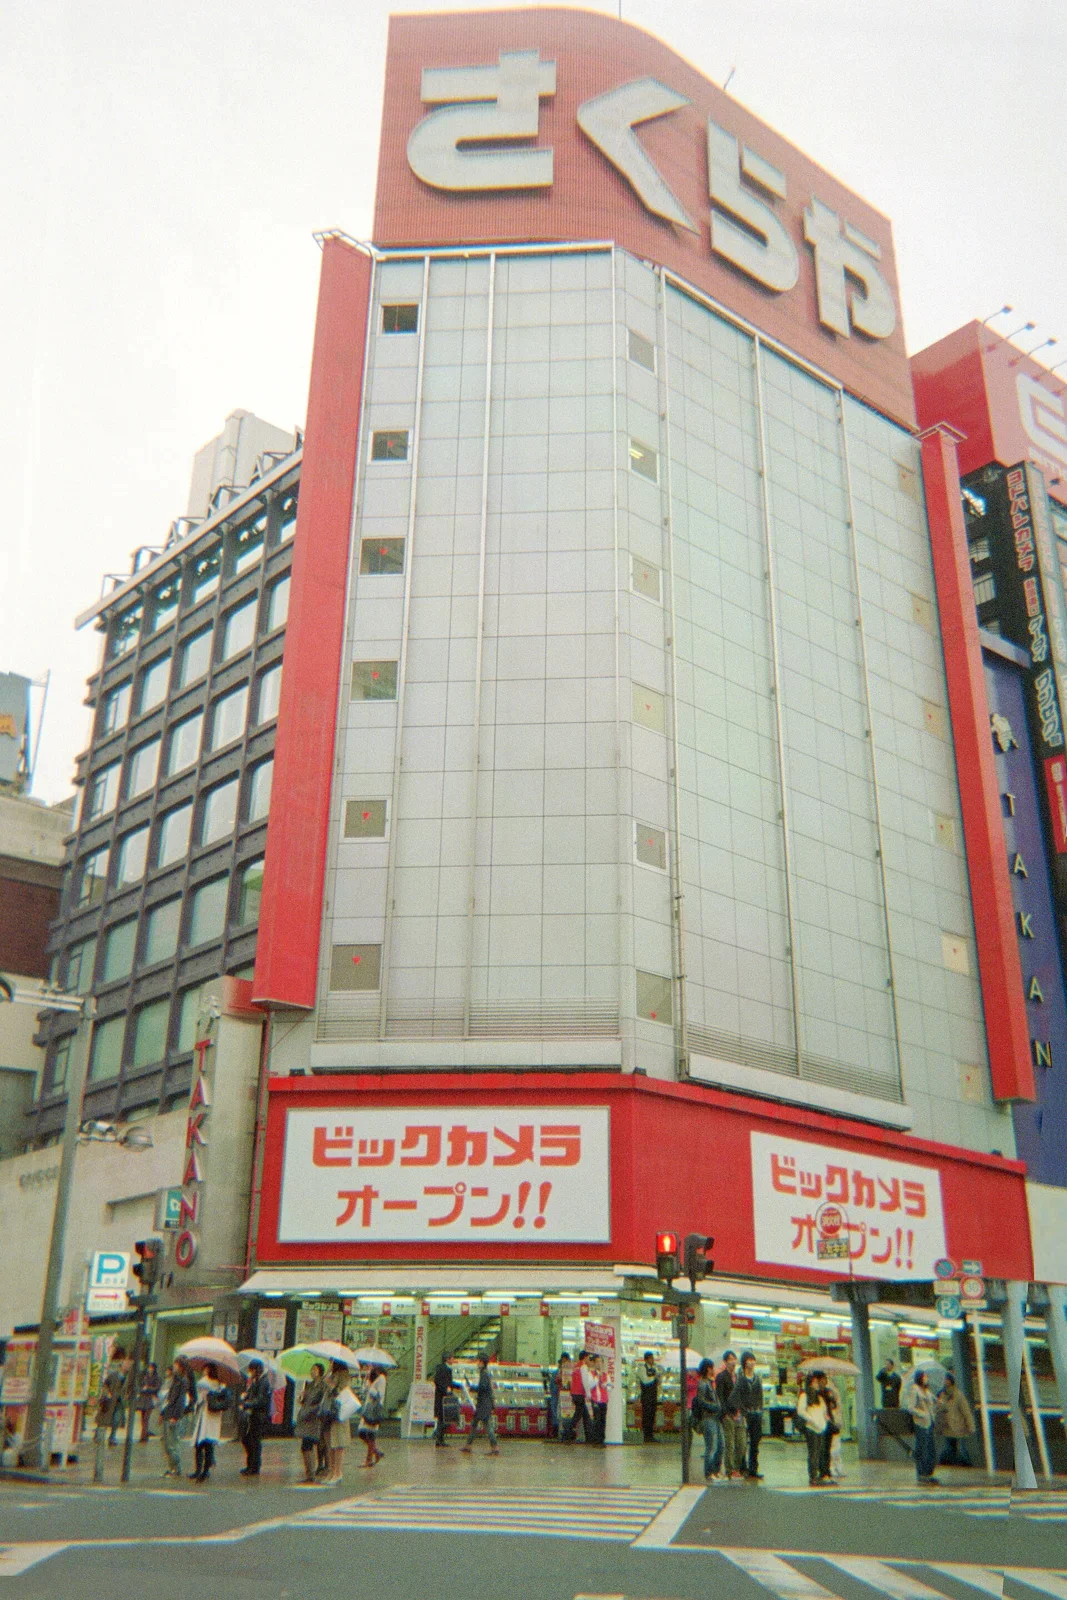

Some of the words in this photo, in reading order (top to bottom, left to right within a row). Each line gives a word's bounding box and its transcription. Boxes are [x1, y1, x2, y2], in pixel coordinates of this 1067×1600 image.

[406, 48, 897, 339] さくらや
[175, 1038, 214, 1268] TAKANO
[312, 1125, 582, 1168] ビックカメラ
[335, 1180, 553, 1230] オープン!!
[770, 1153, 927, 1218] ビックカメラ
[97, 1253, 126, 1284] P
